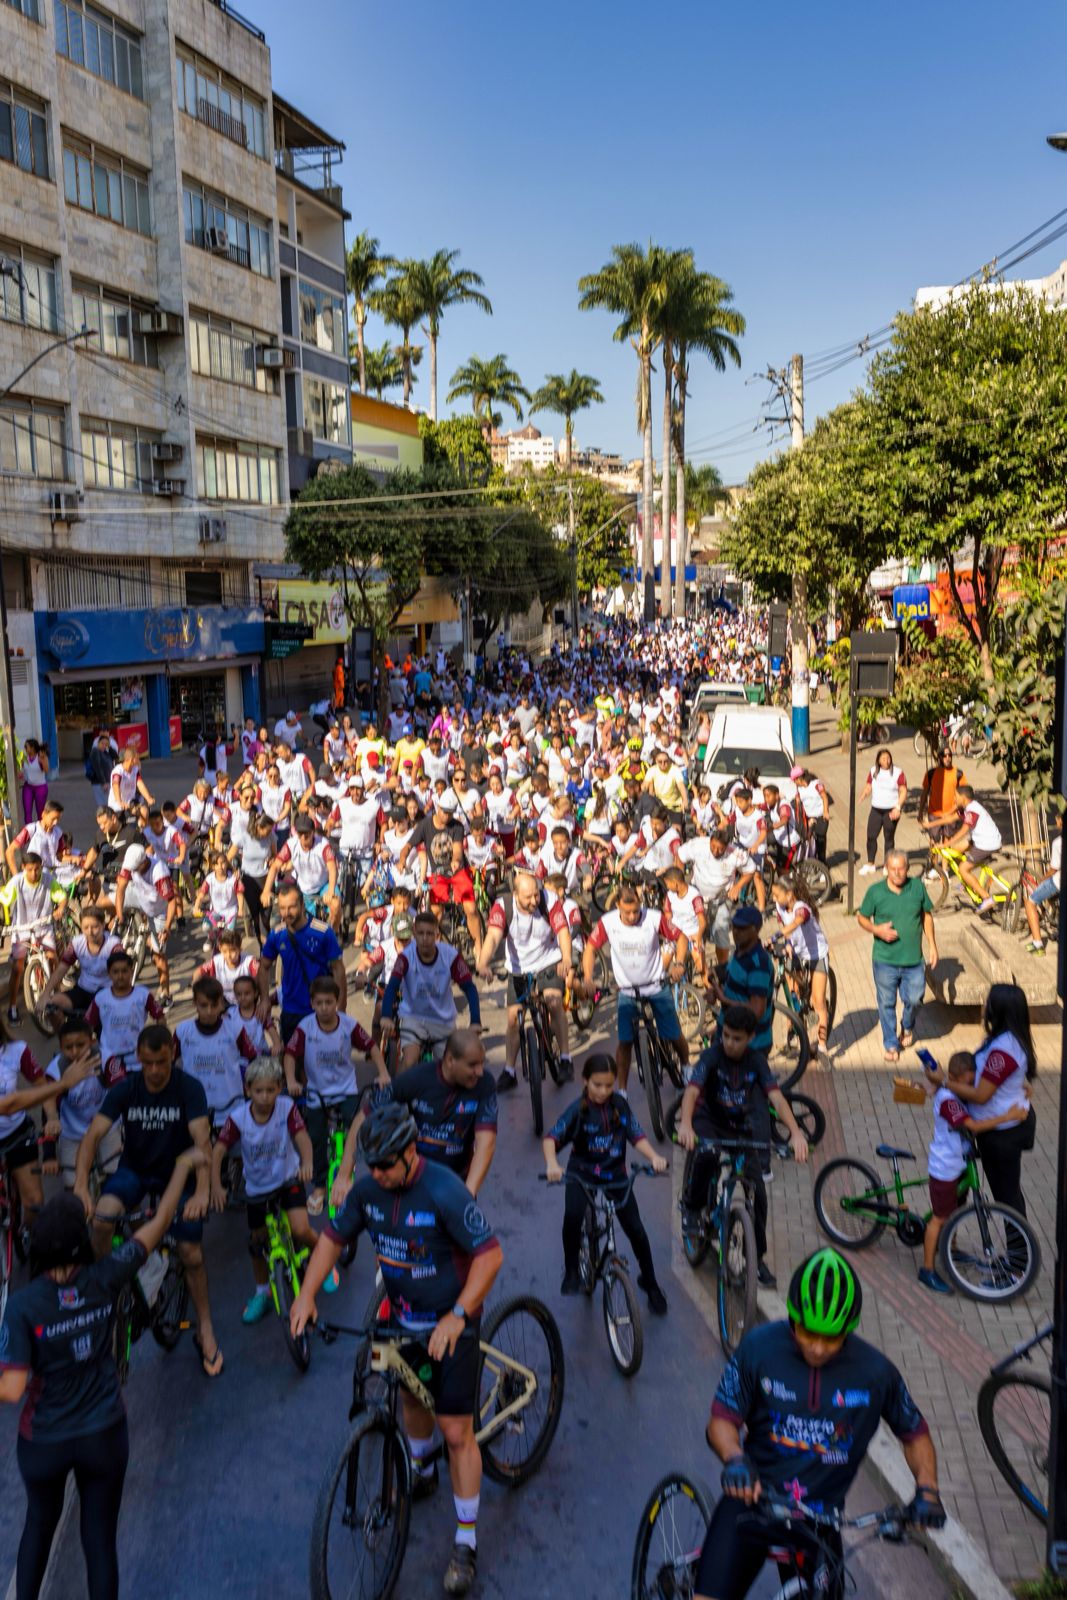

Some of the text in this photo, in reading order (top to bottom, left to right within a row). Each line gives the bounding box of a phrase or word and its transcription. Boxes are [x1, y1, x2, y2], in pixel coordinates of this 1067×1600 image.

[285, 600, 331, 631] CASA
[128, 1106, 180, 1121] BALMAIN
[142, 1120, 164, 1130] PARIS
